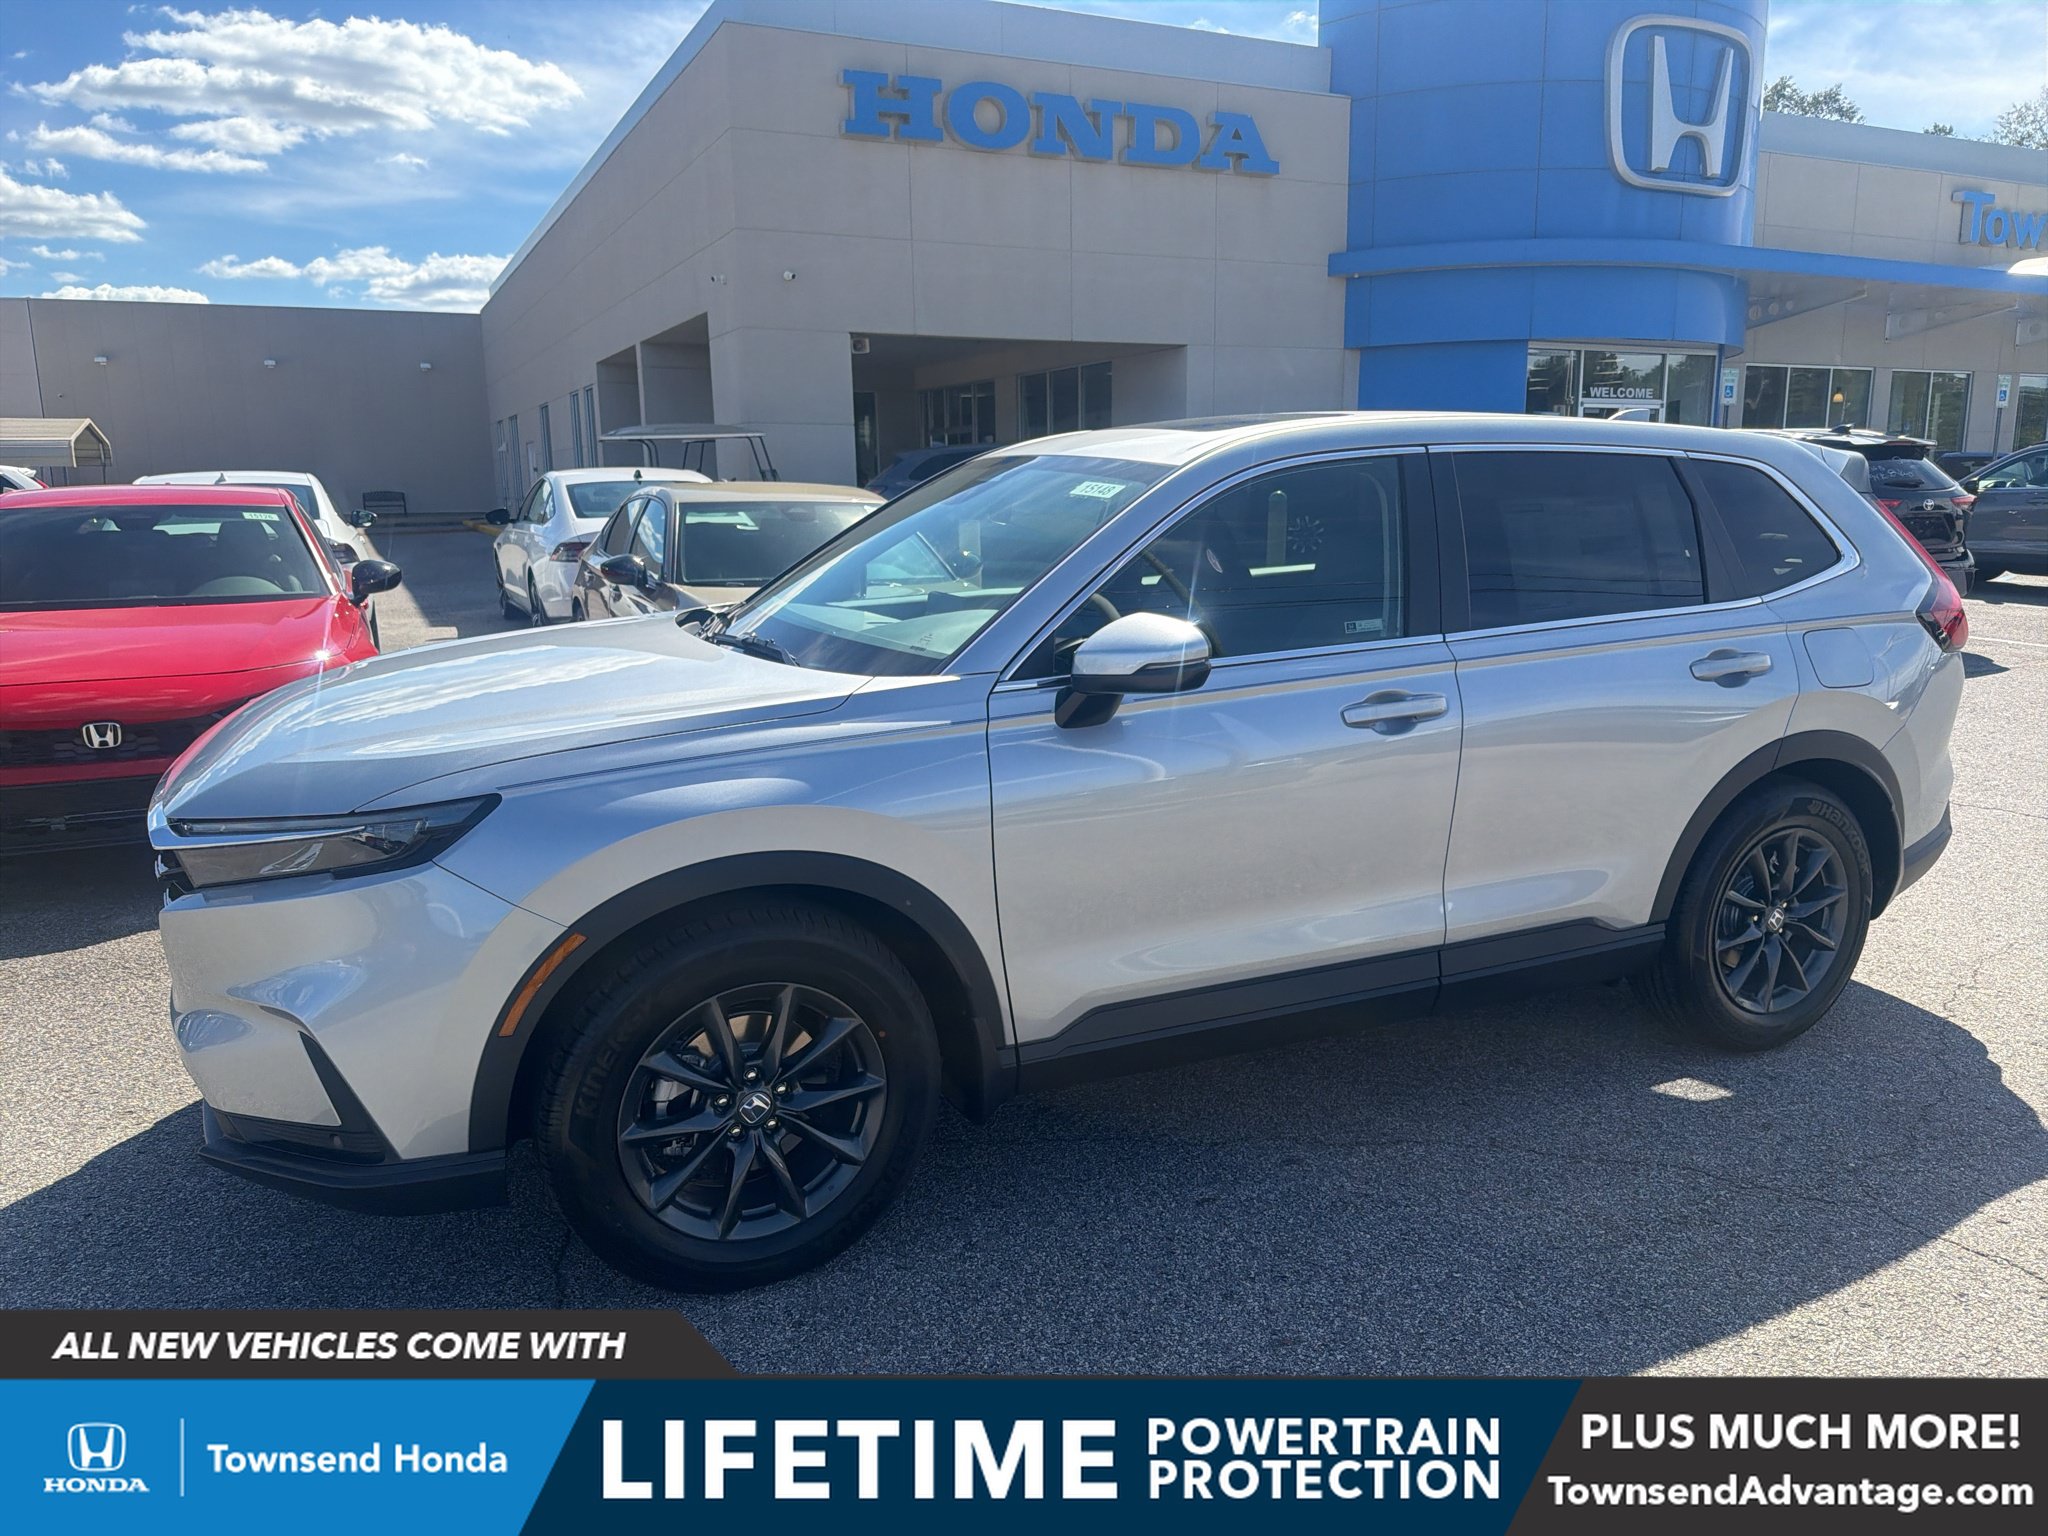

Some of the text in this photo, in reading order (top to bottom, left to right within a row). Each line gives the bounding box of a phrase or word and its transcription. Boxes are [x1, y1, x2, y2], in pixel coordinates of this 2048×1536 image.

[842, 69, 1280, 174] HONDA
[1951, 191, 2048, 249] Tow
[1589, 386, 1654, 399] WELCOME
[1819, 800, 1870, 878] Hankook
